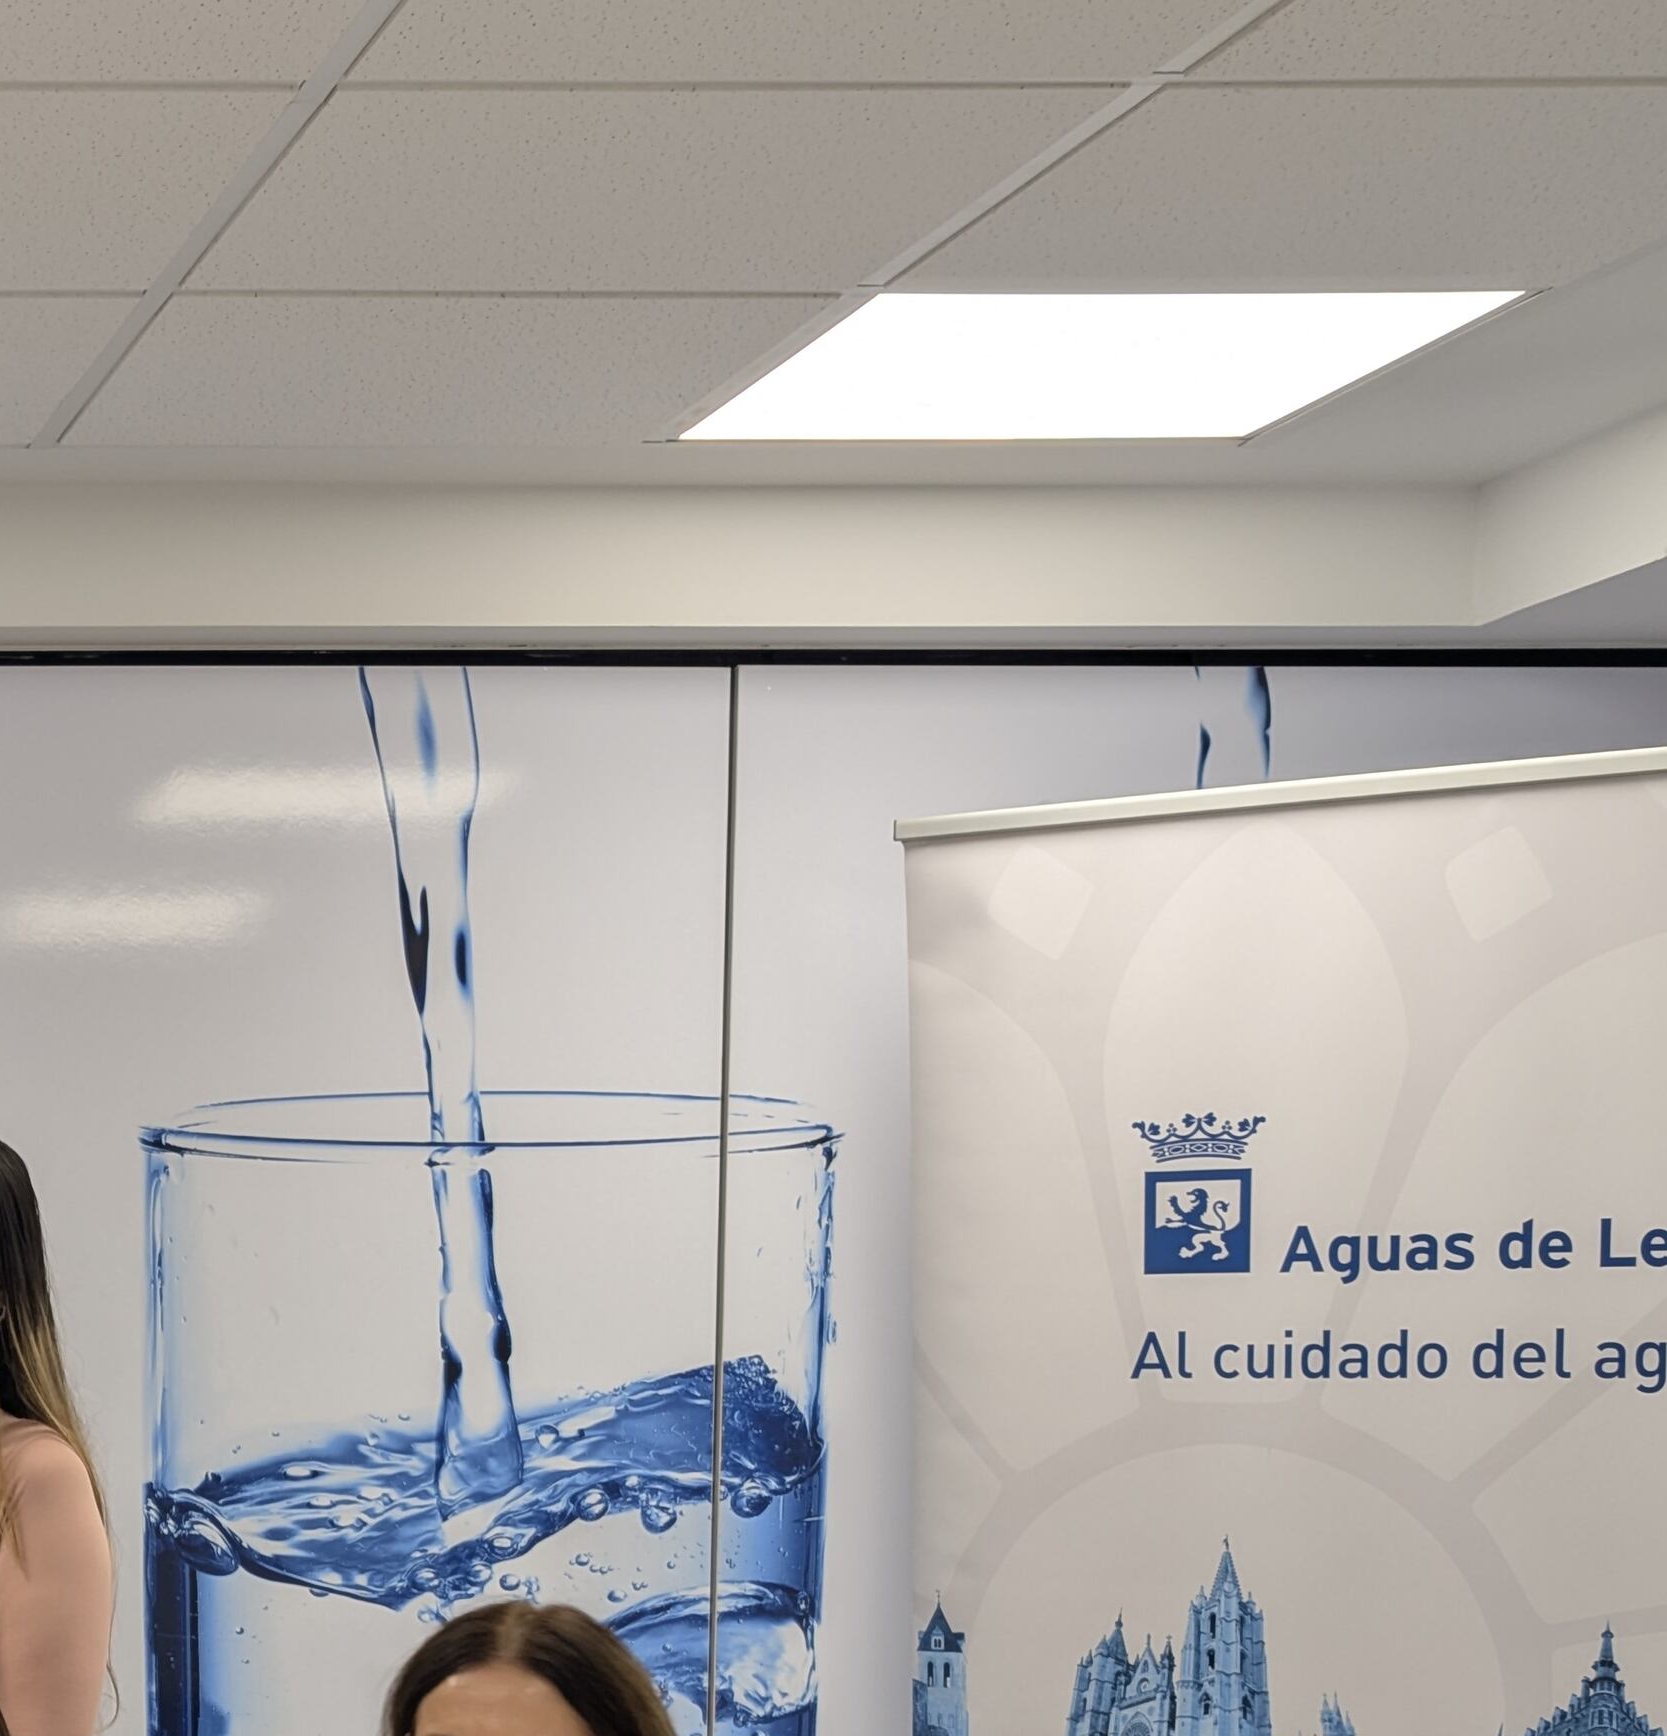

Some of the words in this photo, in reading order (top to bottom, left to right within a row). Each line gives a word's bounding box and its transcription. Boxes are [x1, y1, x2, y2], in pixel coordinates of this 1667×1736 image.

[1279, 1225, 1475, 1285] Aguas
[1498, 1218, 1573, 1270] de
[1599, 1218, 1667, 1270] Le
[1130, 1331, 1193, 1380] Al
[1213, 1329, 1449, 1380] cuidado
[1471, 1328, 1572, 1380] del
[1594, 1341, 1667, 1395] ag
